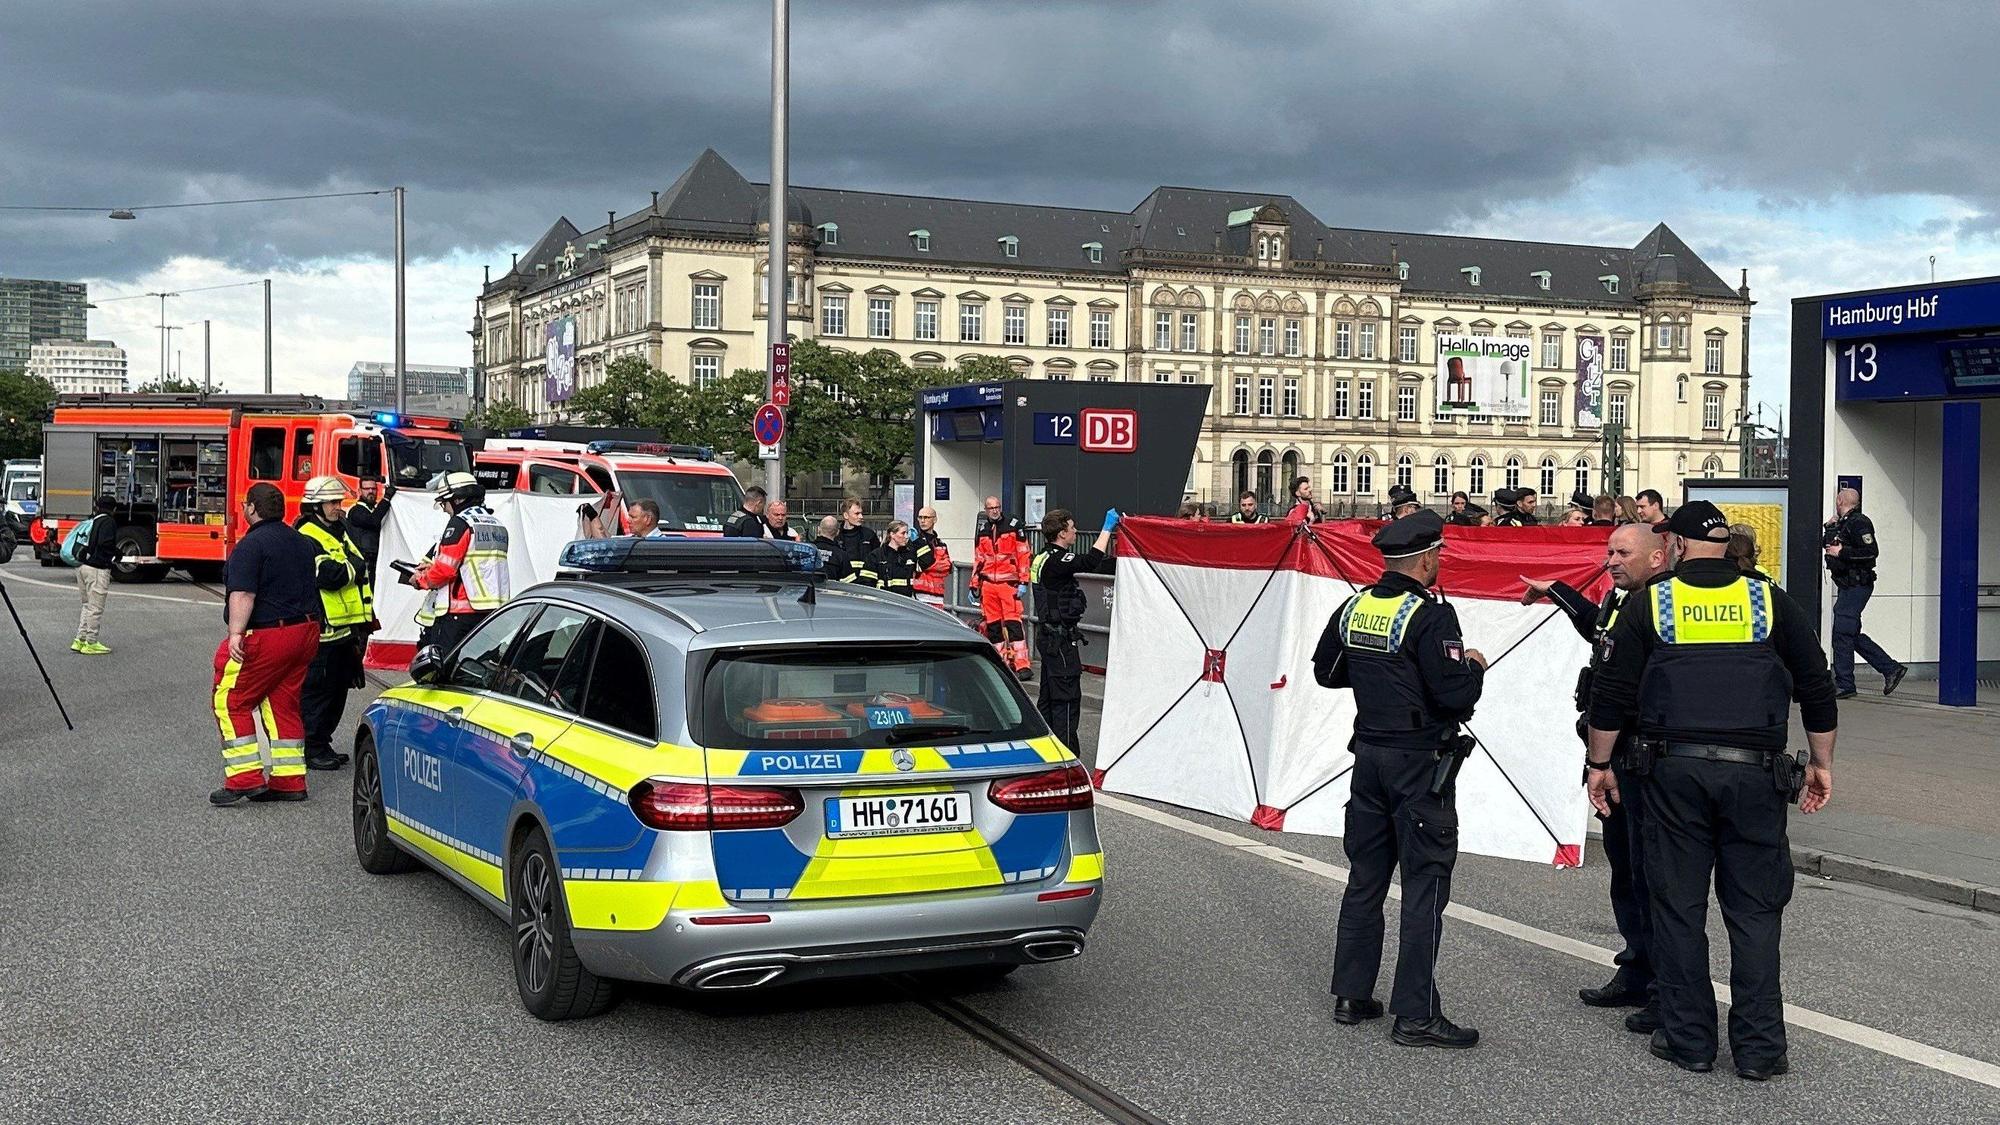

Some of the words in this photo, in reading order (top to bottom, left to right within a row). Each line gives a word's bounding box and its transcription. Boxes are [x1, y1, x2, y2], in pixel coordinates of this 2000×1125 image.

[1829, 302, 1903, 326] Hamburg
[1907, 294, 1939, 319] Hbf
[775, 347, 786, 356] 01
[1439, 337, 1479, 354] Hello
[1482, 339, 1530, 361] Image
[775, 364, 786, 373] 07
[1844, 342, 1878, 382] 13
[1050, 415, 1073, 437] 12
[1089, 416, 1130, 445] DB
[445, 452, 451, 462] 6
[1351, 612, 1391, 632] POLIZEI
[1682, 605, 1743, 622] POLIZEI
[875, 710, 904, 725] 23/10
[404, 746, 441, 792] POLIZEI
[761, 754, 842, 771] POLIZEI
[852, 800, 884, 827] HH
[900, 797, 957, 824] 7160
[831, 819, 837, 828] D
[838, 826, 964, 838] www.polizei.hamburg
